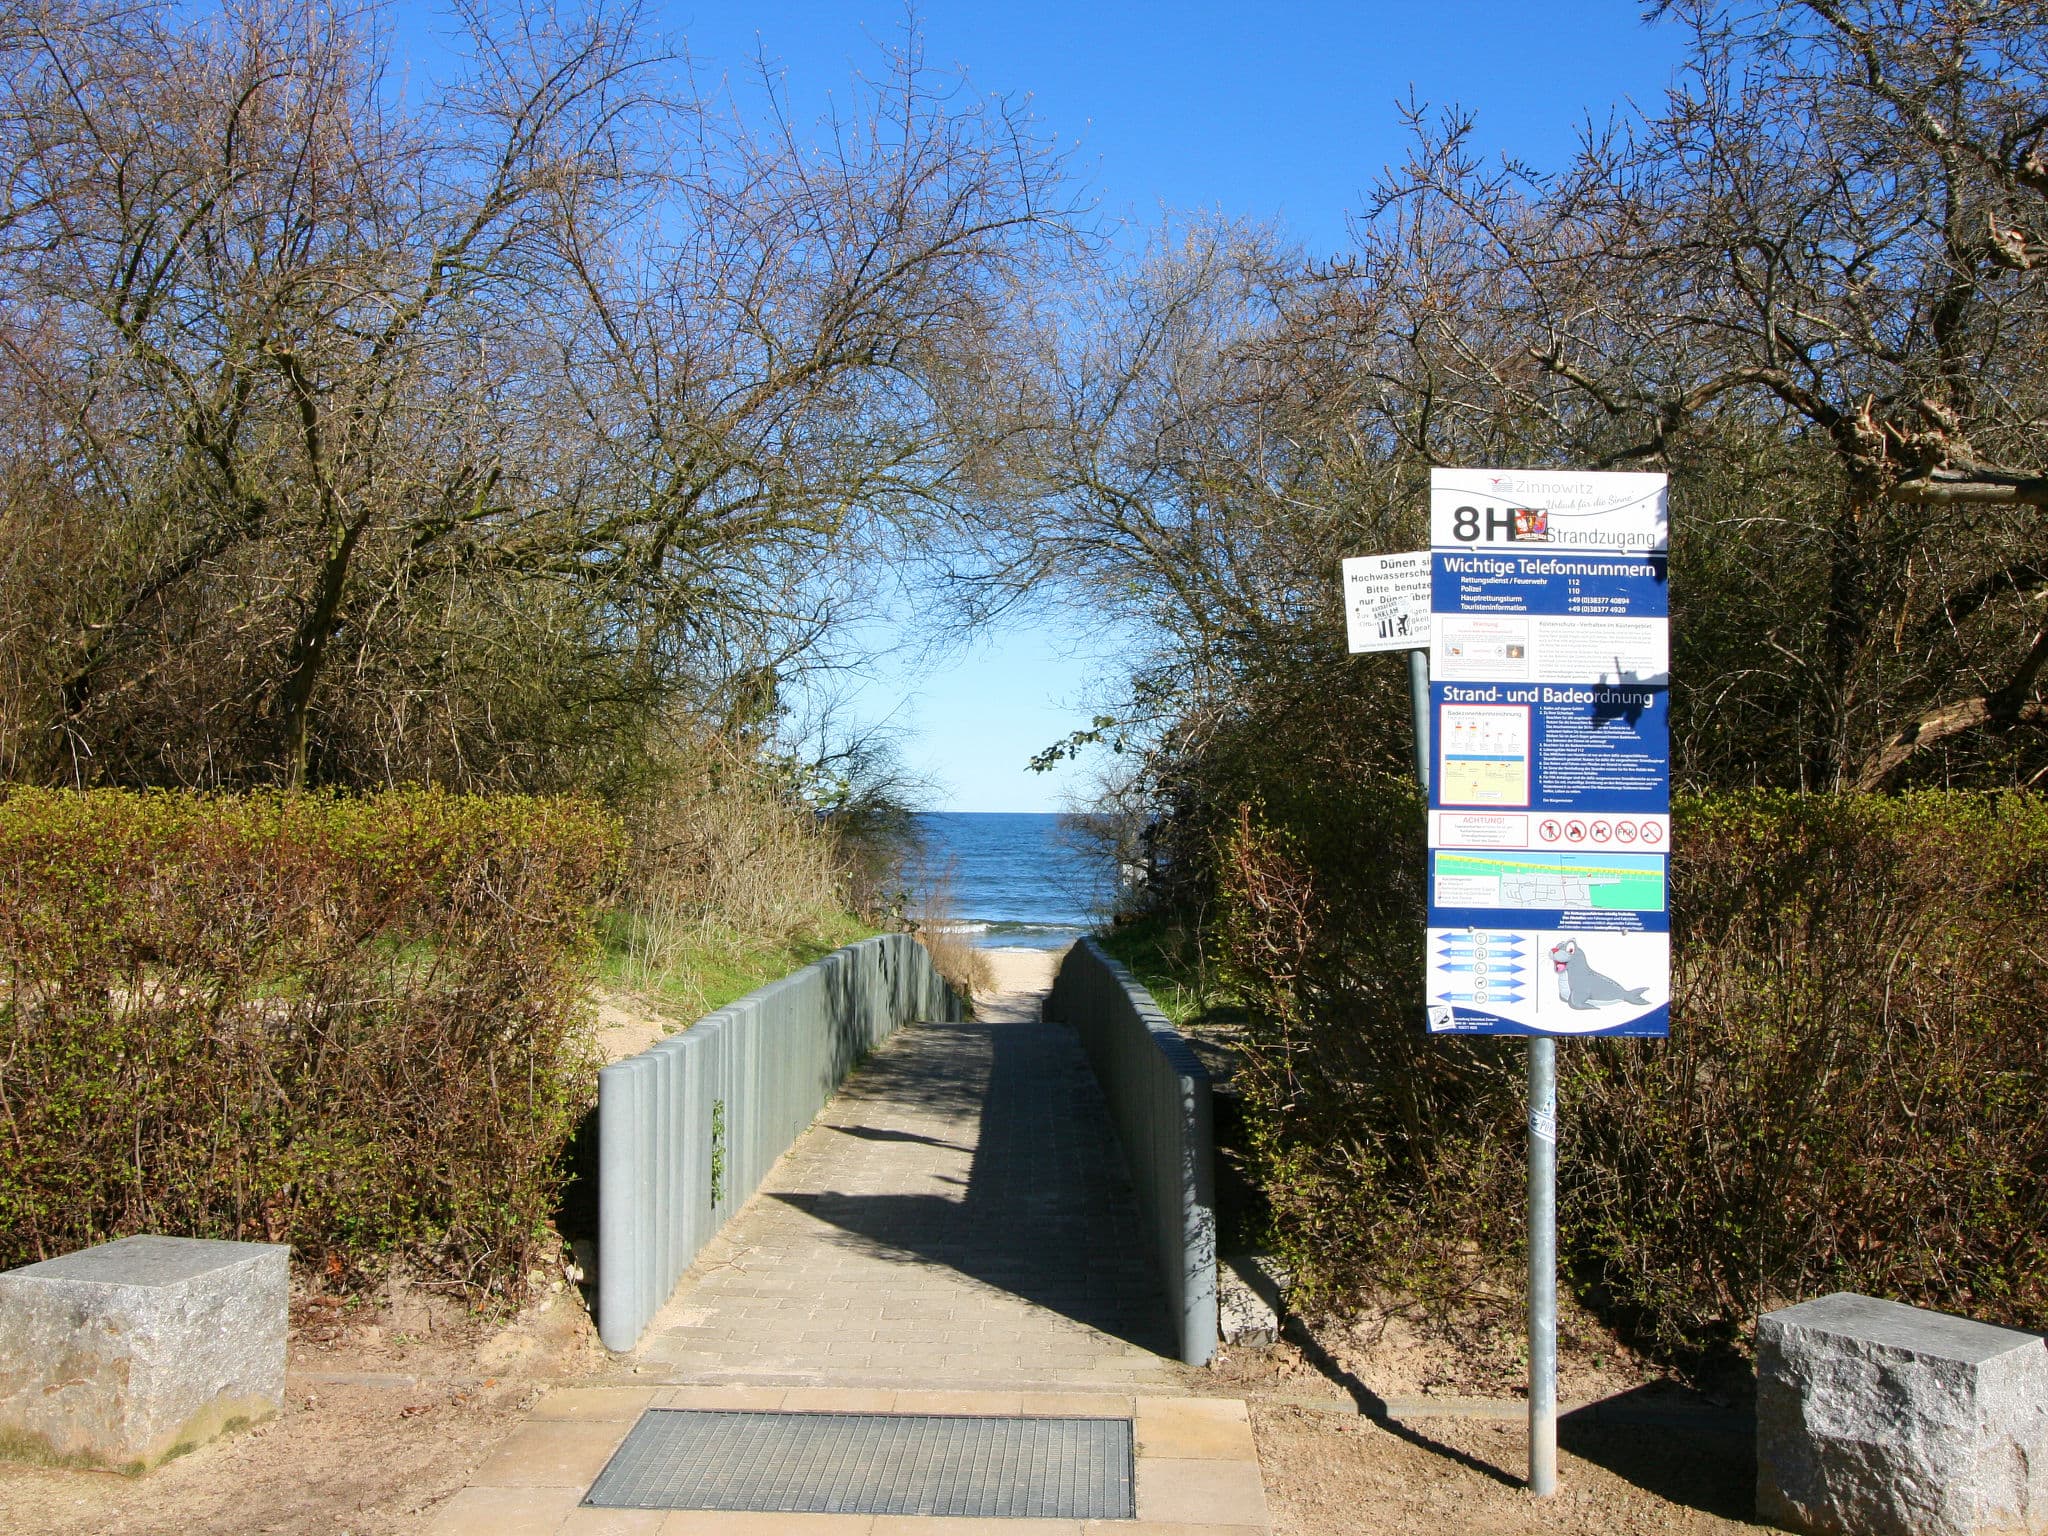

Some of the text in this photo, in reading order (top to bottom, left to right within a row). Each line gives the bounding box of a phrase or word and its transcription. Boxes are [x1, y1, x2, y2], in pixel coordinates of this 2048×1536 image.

[1516, 481, 1593, 494] Zinnowitz
[1453, 506, 1515, 542] 8H
[1546, 527, 1655, 548] Strandzugang
[1380, 560, 1416, 569] Dünen
[1444, 558, 1656, 577] Wichtige Telefonnummern
[1461, 576, 1509, 585] Rettungsdienst
[1513, 577, 1548, 585] Feuerwehr
[1366, 585, 1390, 594] Bitte
[1461, 585, 1580, 595] Polizei 110
[1461, 594, 1523, 604] Hauptrettungsturm
[1461, 603, 1527, 612] Touristeninformation
[1443, 685, 1654, 708] Strand- und Badeordnung
[1463, 816, 1505, 824] ACHTUNG!
